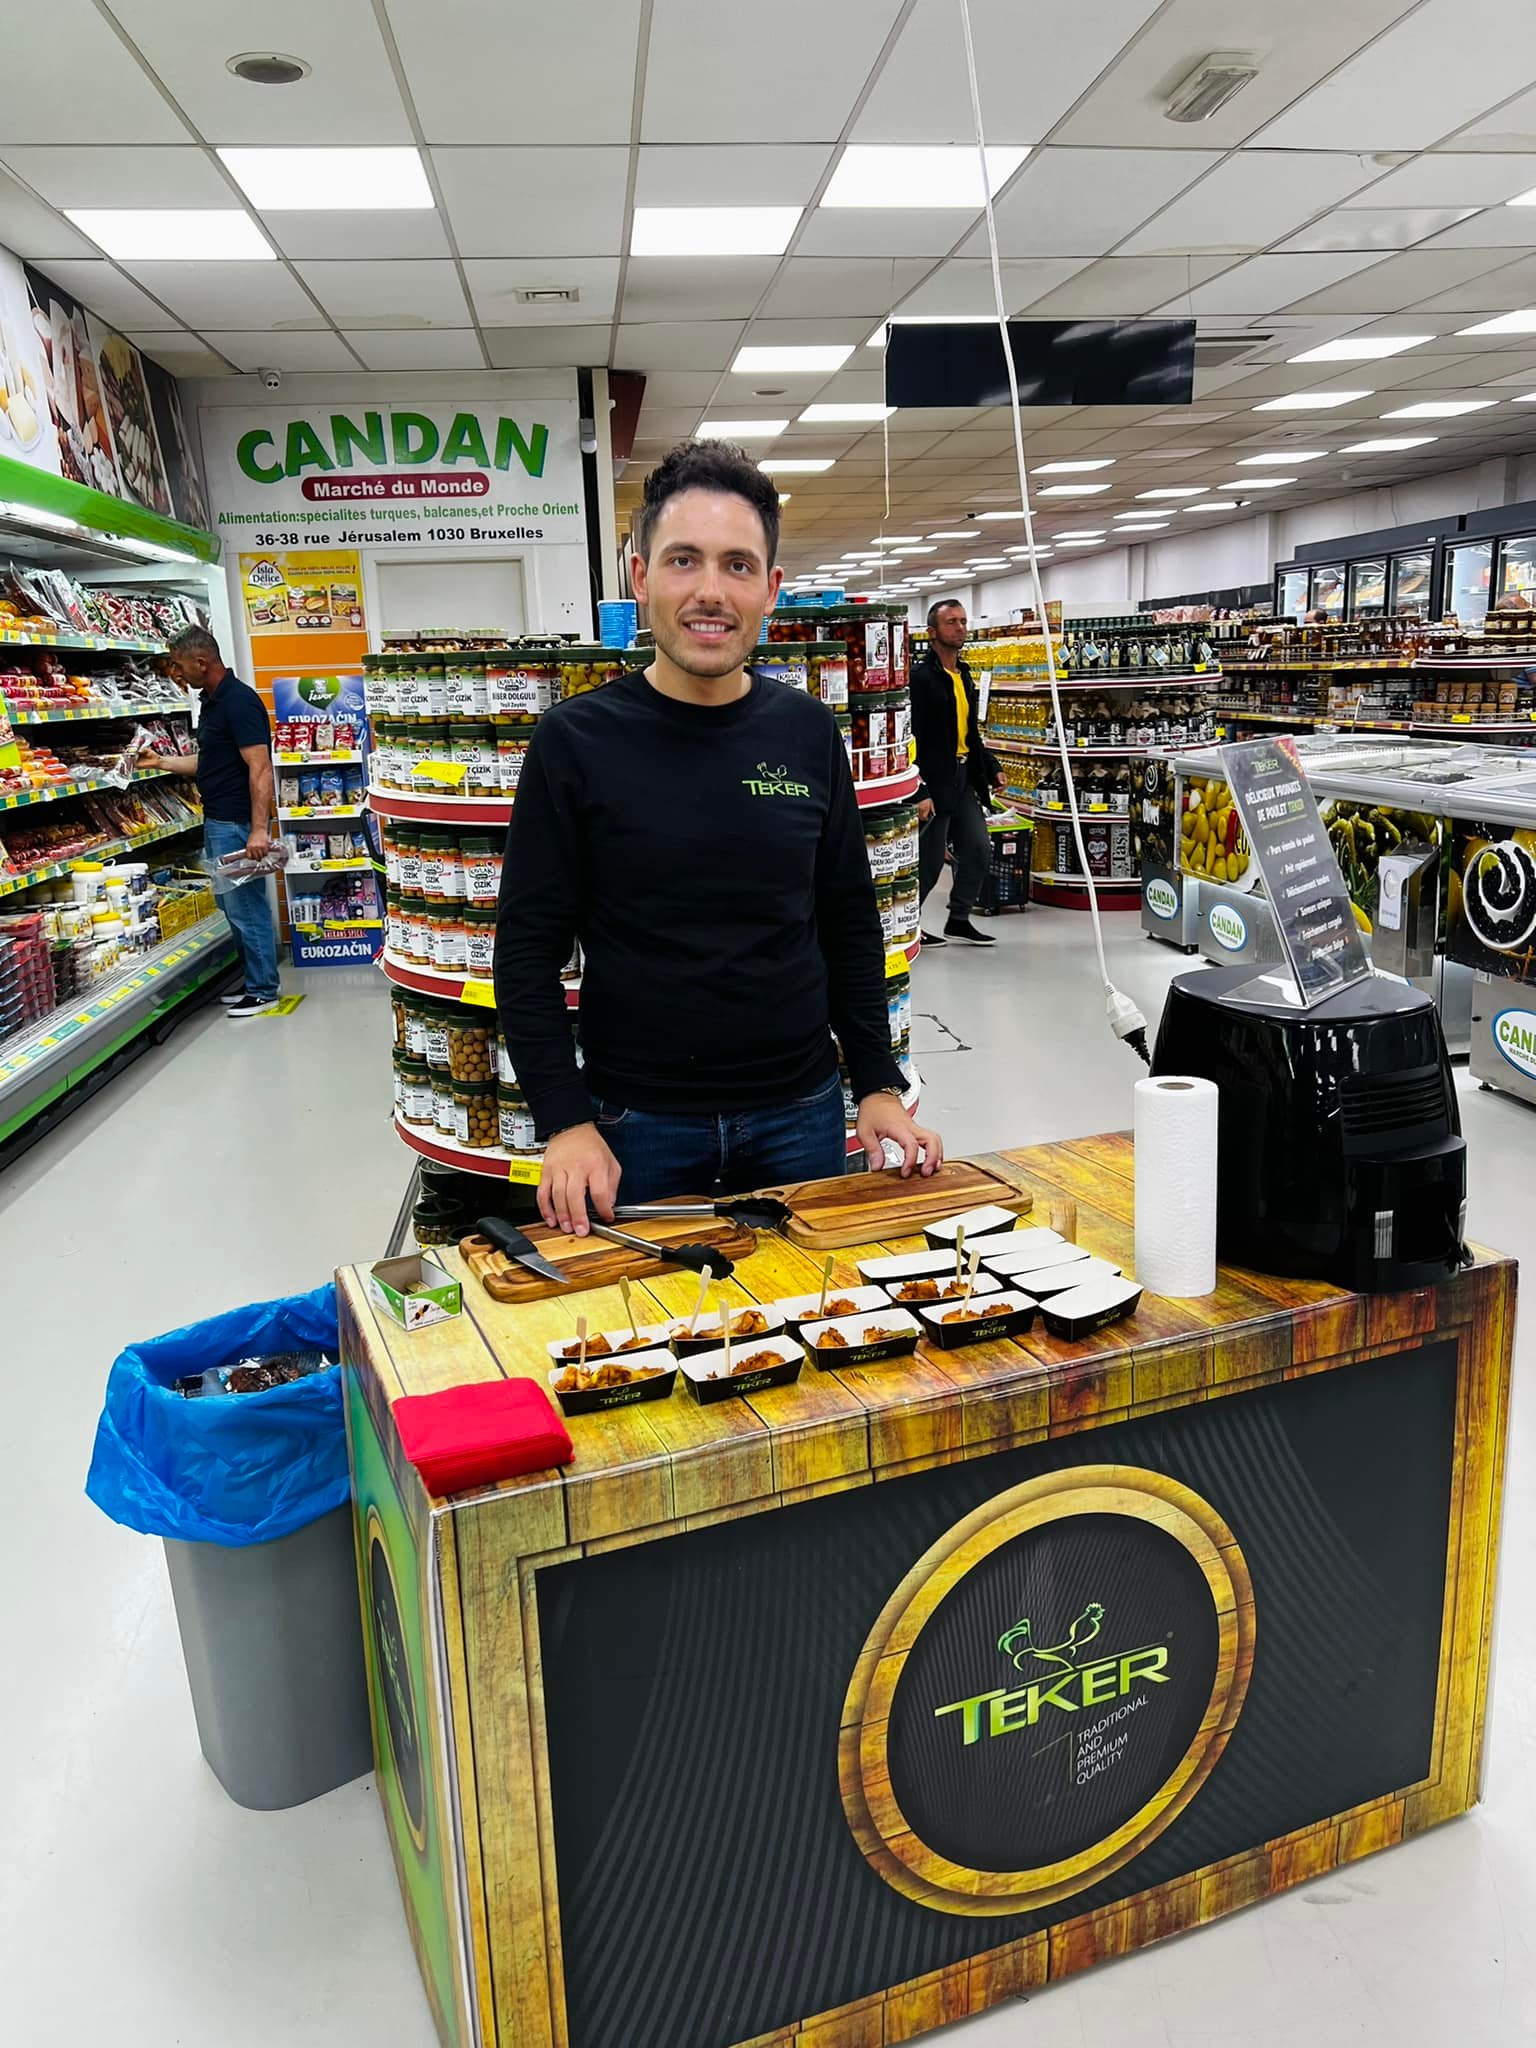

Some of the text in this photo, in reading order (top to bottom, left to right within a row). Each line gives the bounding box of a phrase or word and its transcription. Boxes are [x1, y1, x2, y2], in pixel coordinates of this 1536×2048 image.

[236, 411, 549, 484] CANDAN
[313, 477, 484, 498] Marché du Monde
[370, 506, 420, 522] turques,
[497, 503, 539, 516] Proche
[542, 502, 580, 516] Orient
[255, 526, 544, 547] 36-38 rue Jérusalem 1030 Bruxelles
[257, 565, 274, 574] Isla
[741, 780, 811, 798] TEKER
[1148, 887, 1176, 909] CANDAN
[1211, 912, 1244, 940] CANDAN
[301, 940, 373, 959] EUROZAČIN
[971, 1325, 1007, 1338] TEKER
[850, 1350, 889, 1362] TEKER
[733, 1378, 772, 1391] TEKER
[600, 1391, 641, 1405] TEKER
[934, 1646, 1171, 1746] TEKER
[1076, 1694, 1150, 1743] TRADITIONAL
[1076, 1735, 1103, 1759] AND
[1076, 1732, 1130, 1773] PREMIUM
[1076, 1749, 1124, 1785] QUALITY
